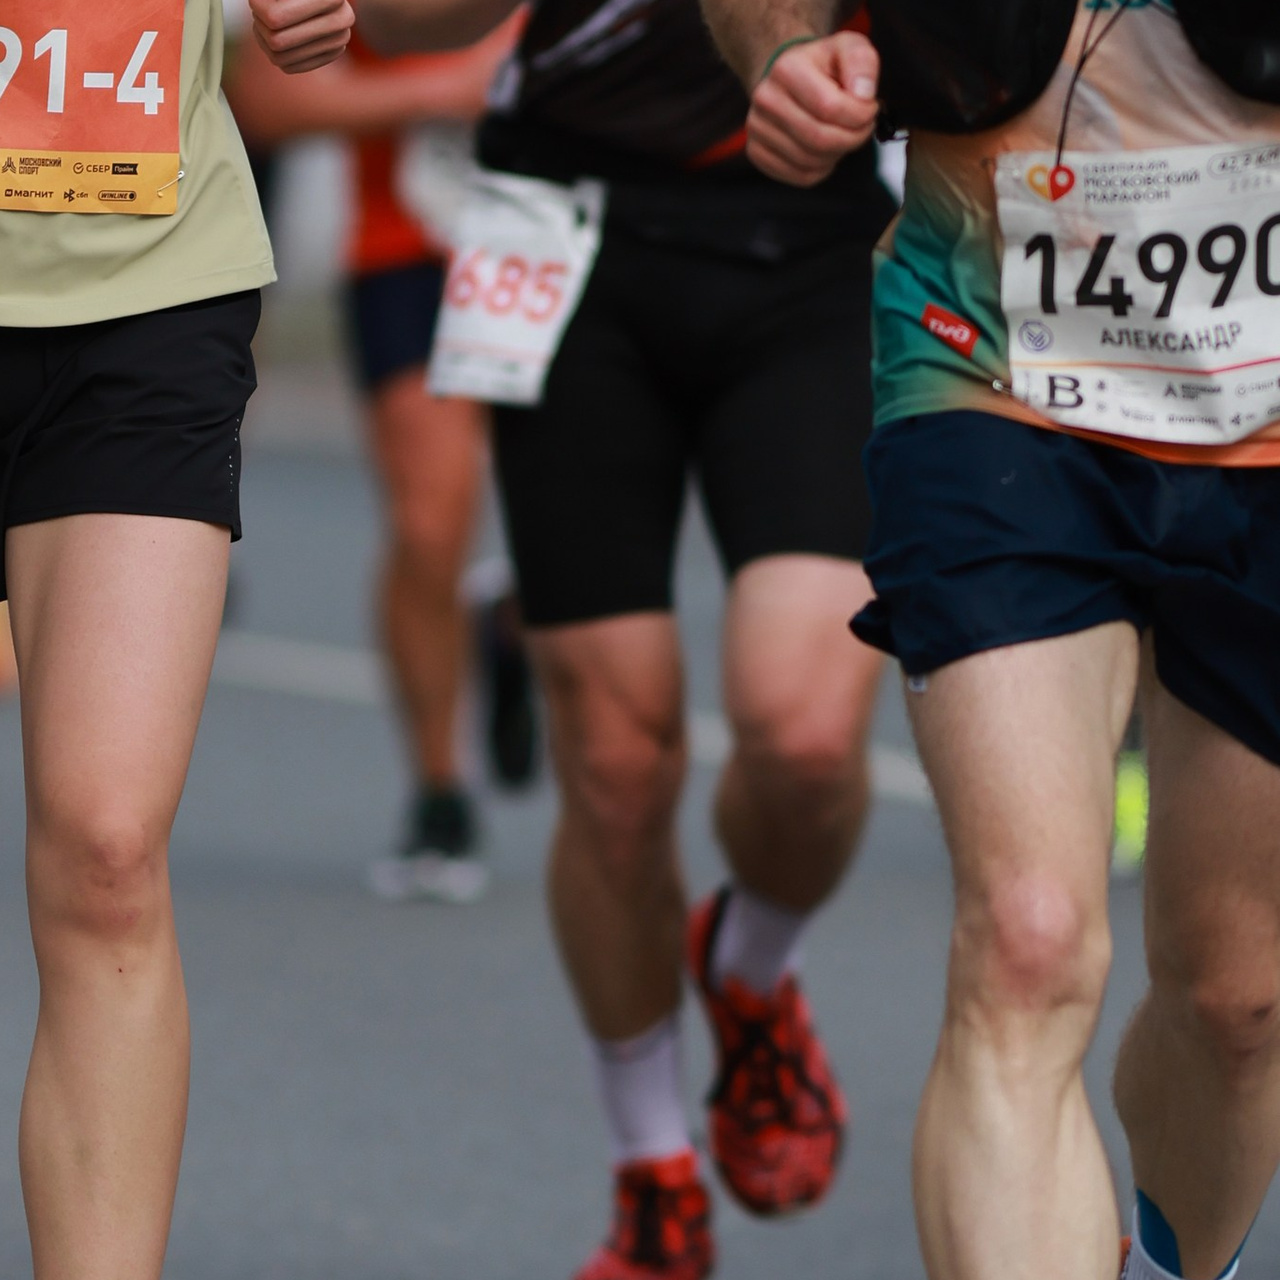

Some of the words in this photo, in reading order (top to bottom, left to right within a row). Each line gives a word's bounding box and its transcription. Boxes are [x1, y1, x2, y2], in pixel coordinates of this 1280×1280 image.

[19, 157, 62, 167] МОСКОВСКИЙ
[19, 166, 39, 175] СПОРТ
[86, 164, 111, 173] СБЕР
[1100, 322, 1242, 352] АЛЕКСАНДР
[1047, 375, 1084, 408] B
